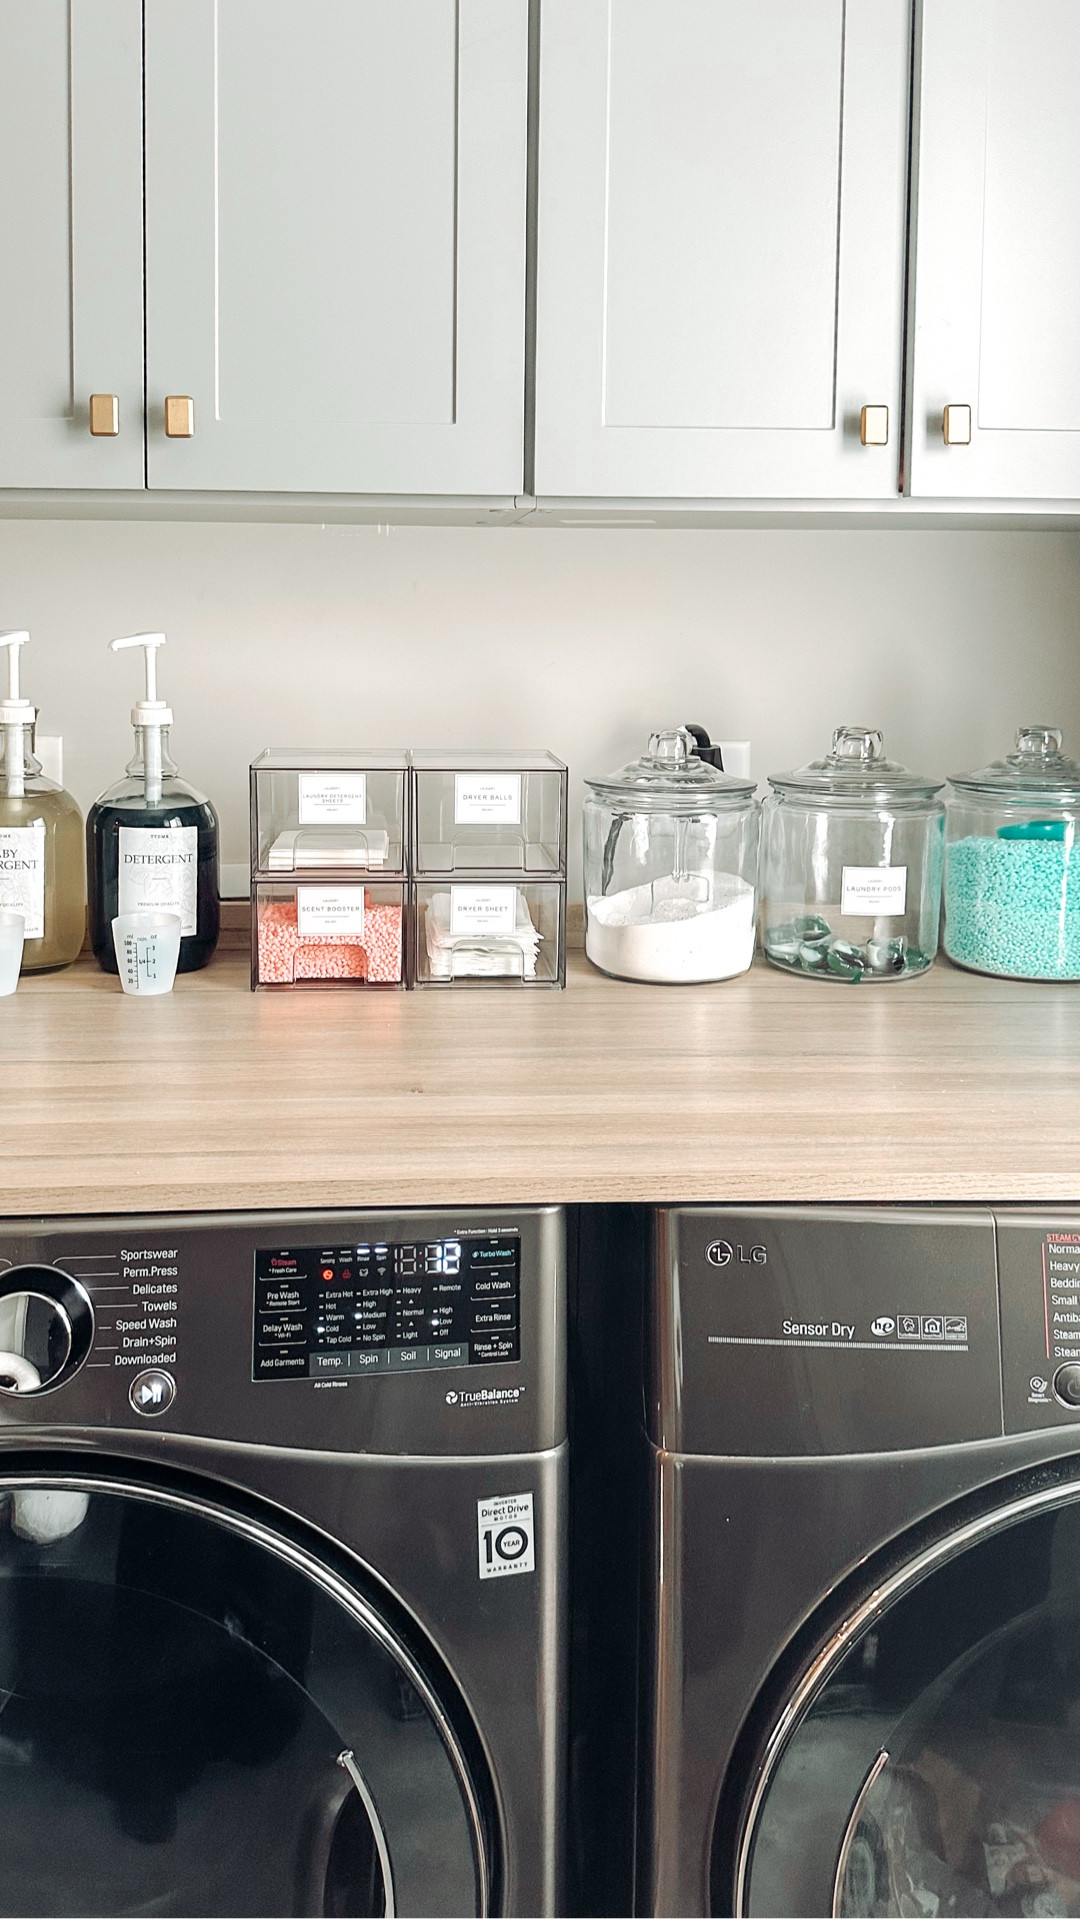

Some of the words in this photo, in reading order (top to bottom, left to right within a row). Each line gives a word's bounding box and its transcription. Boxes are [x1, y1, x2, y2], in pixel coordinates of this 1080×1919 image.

[124, 854, 193, 864] DETERGENT
[120, 1249, 178, 1262] Sportswear
[736, 1244, 766, 1265] LG
[1050, 1261, 1080, 1273] Heavy
[133, 1283, 178, 1294] Delicates
[475, 1282, 491, 1290] Cold
[492, 1281, 510, 1289] Wash
[280, 1291, 299, 1299] Wash
[380, 1288, 393, 1297] High
[1052, 1295, 1078, 1305] Small
[142, 1301, 177, 1312] Towels
[116, 1320, 146, 1332] Speed
[149, 1317, 177, 1328] Wash
[263, 1325, 282, 1333] Delay
[783, 1320, 829, 1336] Sensor
[832, 1322, 855, 1339] Dry
[123, 1335, 176, 1348] Drain+Spin
[498, 1342, 513, 1350] Spin
[115, 1352, 176, 1365] Downloaded
[317, 1356, 343, 1367] Temp.
[360, 1354, 378, 1365] Spin
[400, 1351, 417, 1361] Soil
[435, 1348, 461, 1359] Signal
[482, 1507, 505, 1517] Direct
[508, 1504, 529, 1513] Drive
[484, 1526, 528, 1564] 10
[487, 1562, 528, 1573] WARRANTY
